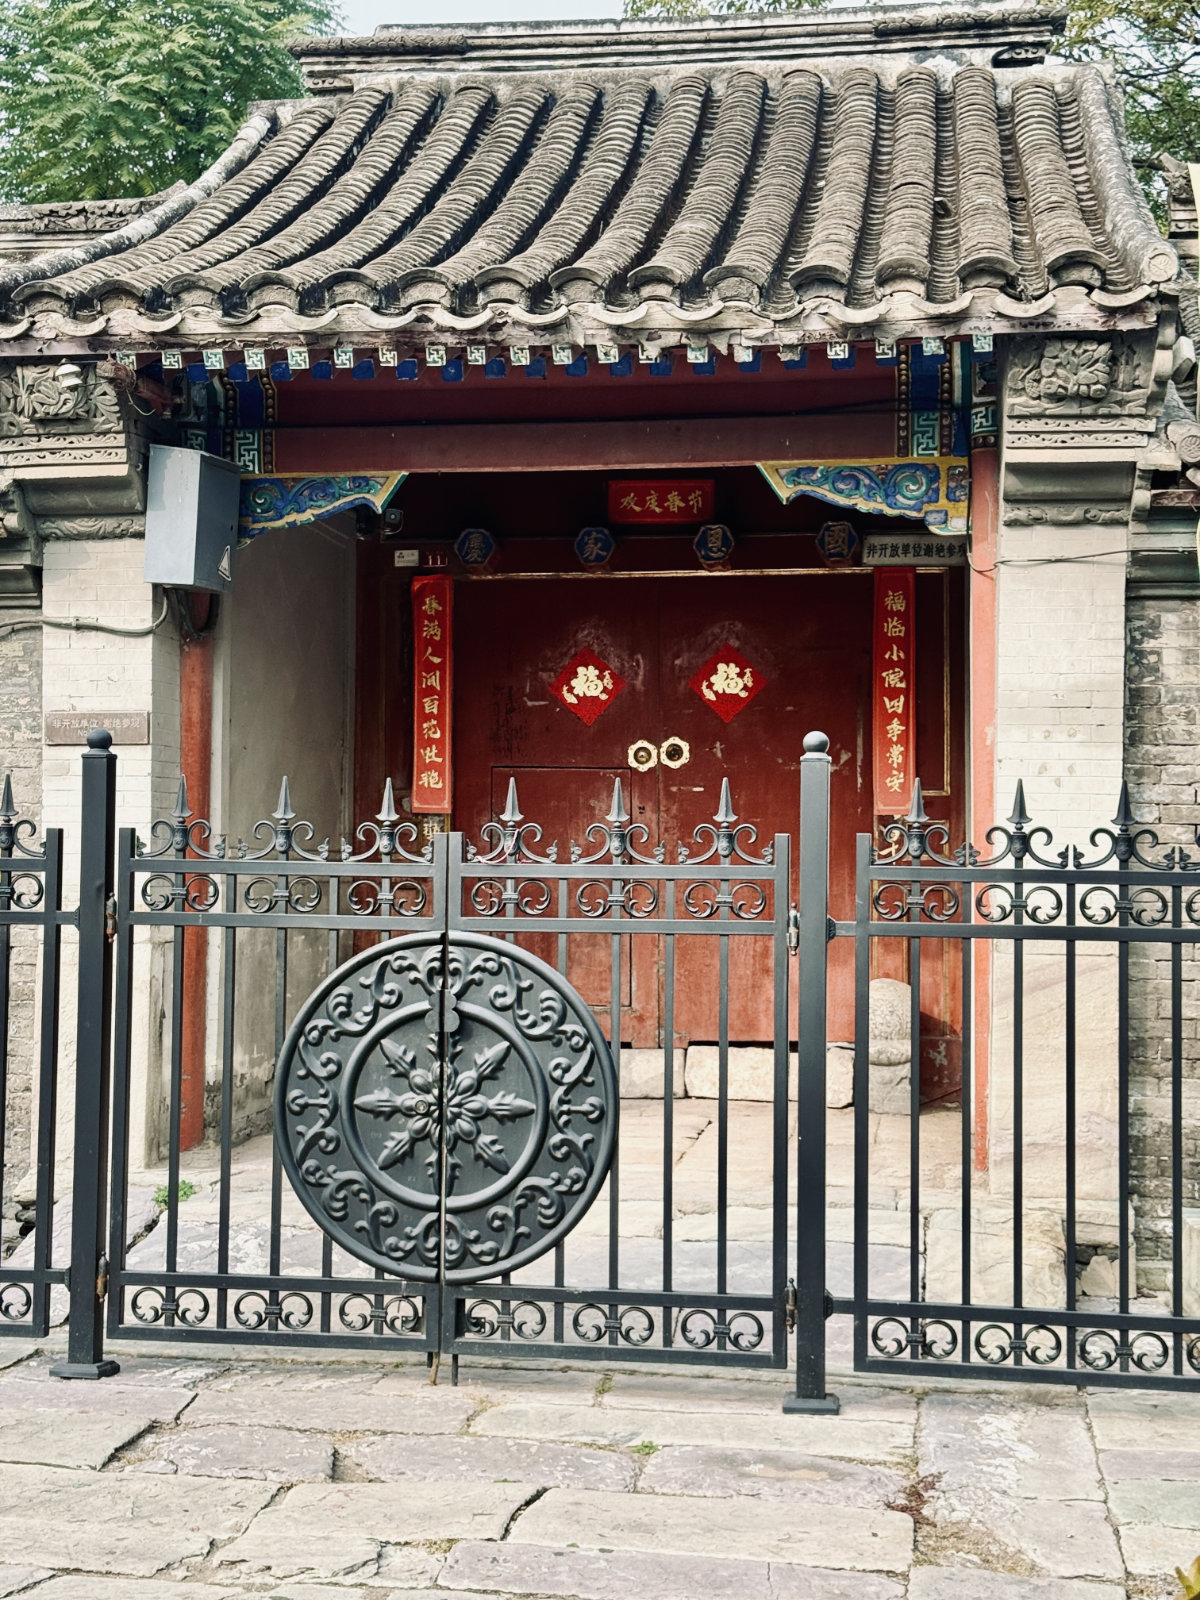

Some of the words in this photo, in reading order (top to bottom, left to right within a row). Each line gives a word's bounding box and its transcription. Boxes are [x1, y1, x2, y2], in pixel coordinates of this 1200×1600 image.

[619, 489, 703, 514] 欢度春节
[583, 531, 608, 560] 家
[419, 594, 443, 789] 春满人间百花吐艳
[570, 665, 604, 697] 福
[710, 662, 744, 694] 福
[881, 590, 906, 793] 福临小院四季常安
